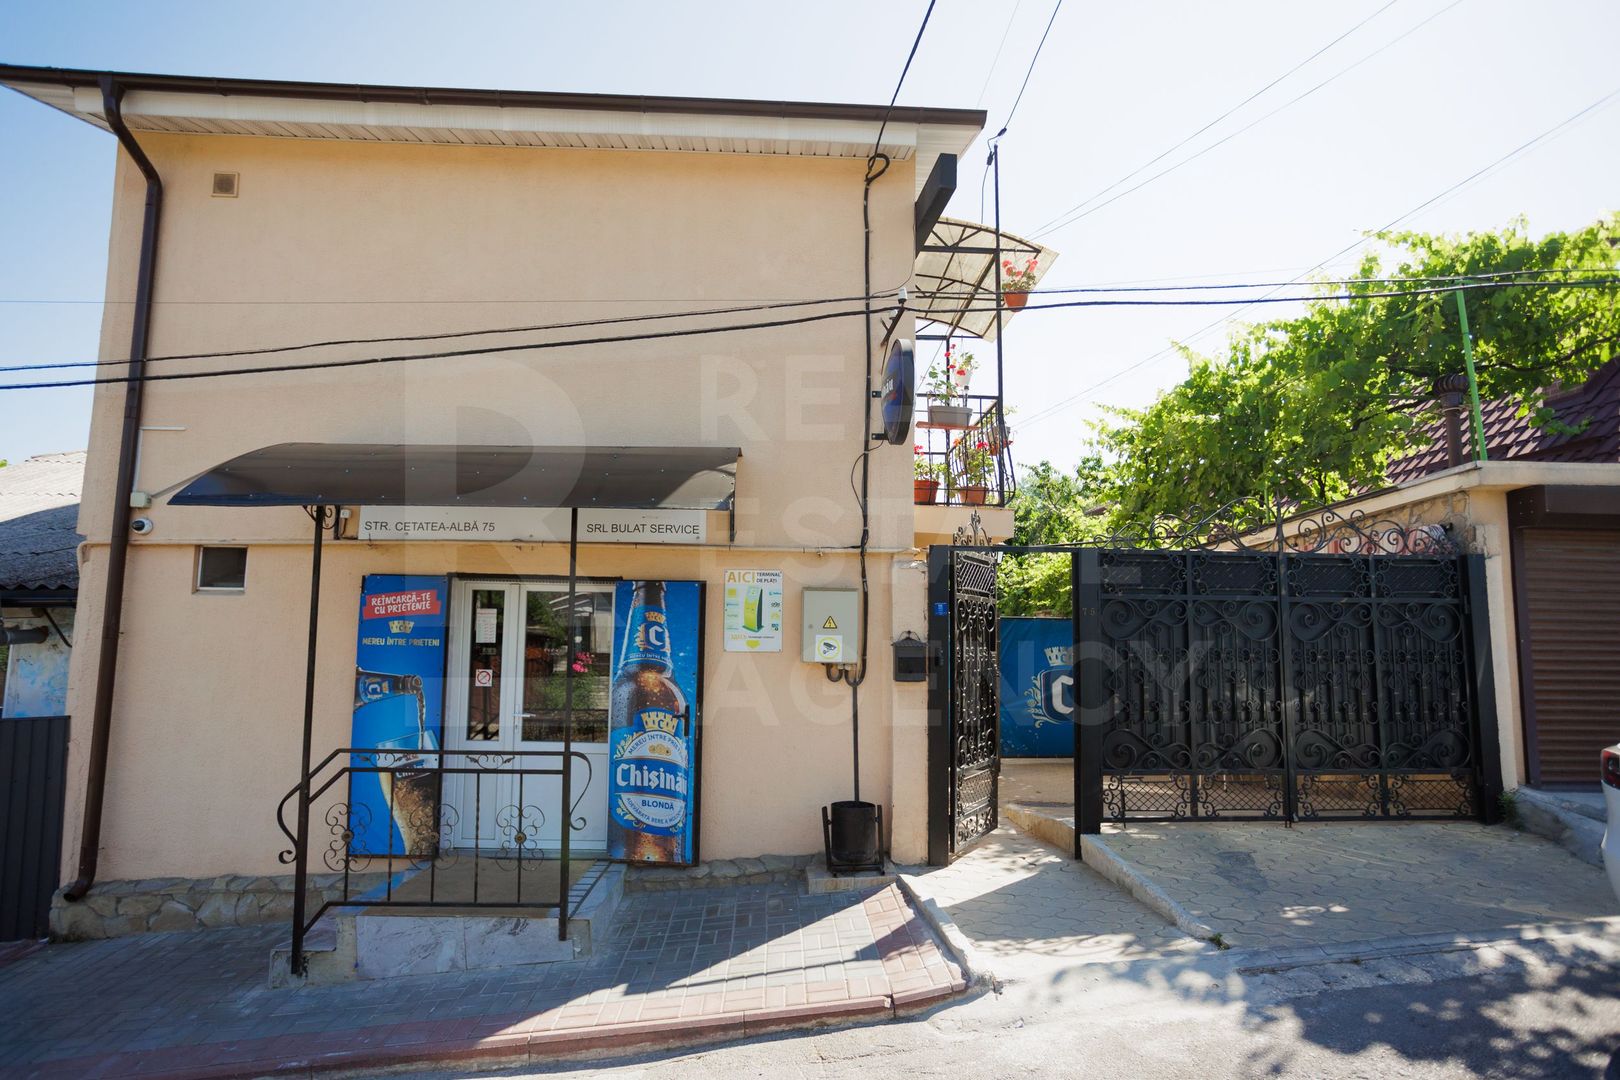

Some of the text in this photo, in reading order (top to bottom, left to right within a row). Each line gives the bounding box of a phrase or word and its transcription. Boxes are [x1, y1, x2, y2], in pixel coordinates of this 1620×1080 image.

[364, 520, 496, 532] STR. CETATEA-ALBĂ 75
[586, 523, 700, 535] SRL BULAT SERVICE
[371, 592, 431, 607] REÎNCARCĂ-TE
[374, 601, 431, 614] CU PRIETENIE
[362, 636, 440, 647] MEREU ÎNTRE PRIETENI
[628, 737, 647, 755] MEREU
